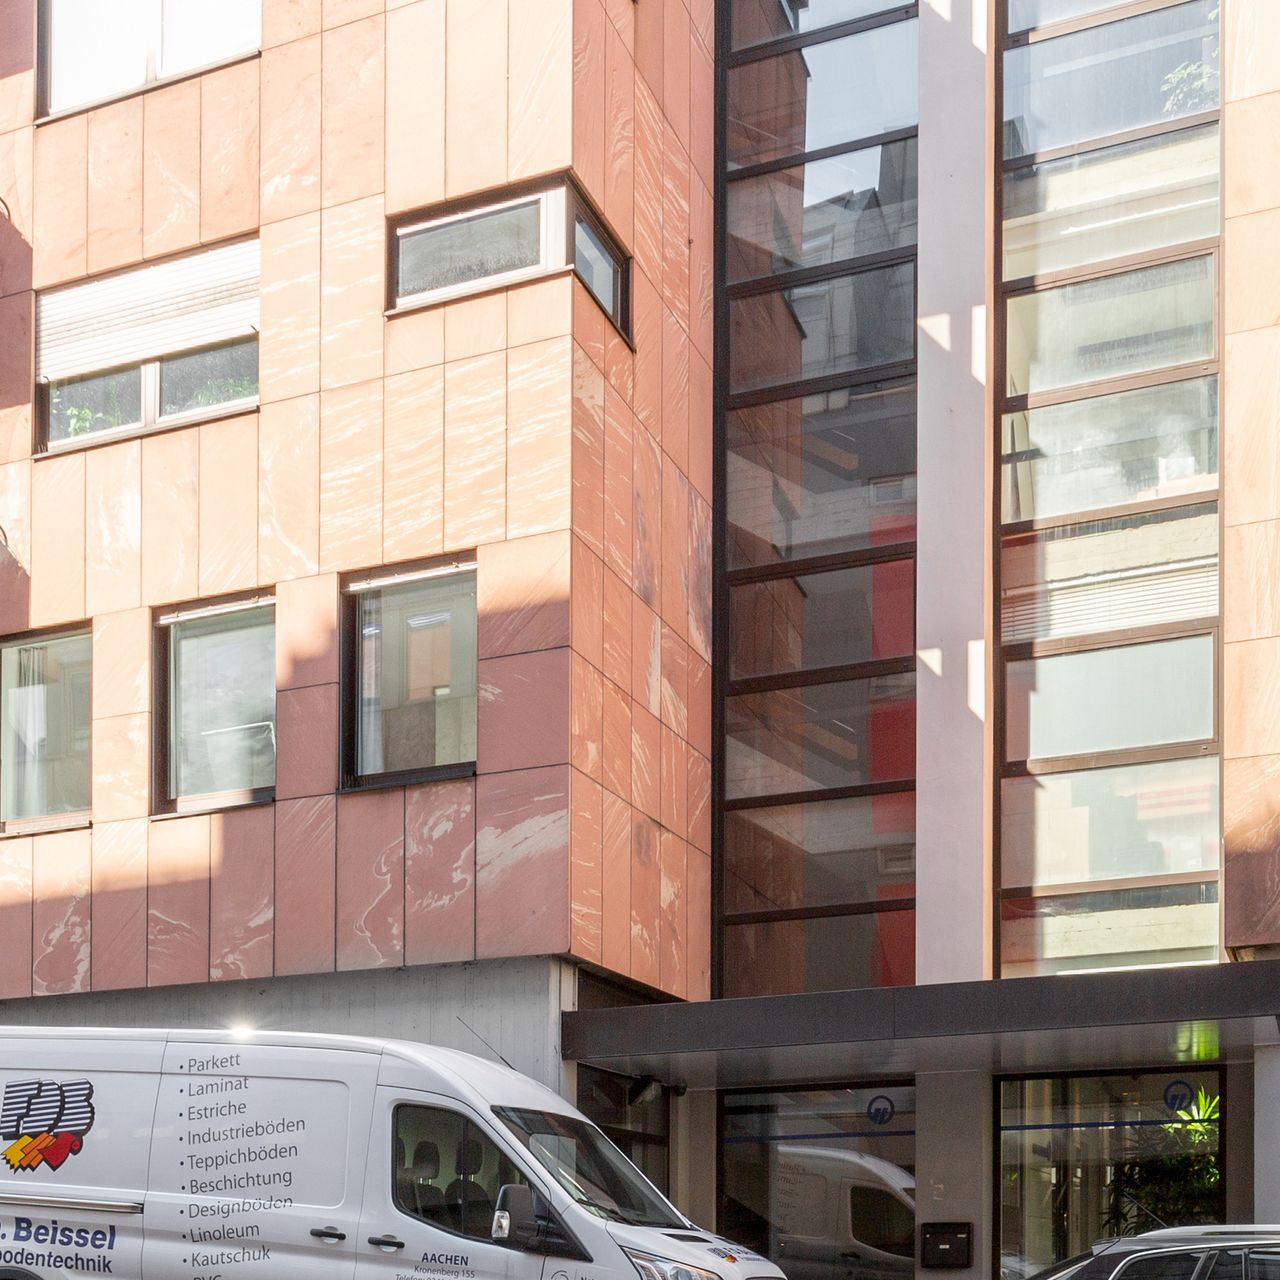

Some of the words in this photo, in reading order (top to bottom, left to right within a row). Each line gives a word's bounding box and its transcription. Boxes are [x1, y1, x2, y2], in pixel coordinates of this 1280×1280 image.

[188, 1053, 240, 1073] Parkett
[188, 1076, 249, 1096] Laminat
[188, 1100, 247, 1120] Estriche
[187, 1118, 306, 1145] Industrieböden
[187, 1144, 298, 1171] Teppichböden
[190, 1171, 293, 1194] Beschichtung
[188, 1195, 293, 1218] Designböden
[13, 1217, 116, 1250] Beissel
[190, 1224, 260, 1243] Linoleum
[192, 1245, 271, 1267] Kautschuk
[421, 1252, 469, 1266] AACHEN
[414, 1265, 459, 1278] Kronenberg
